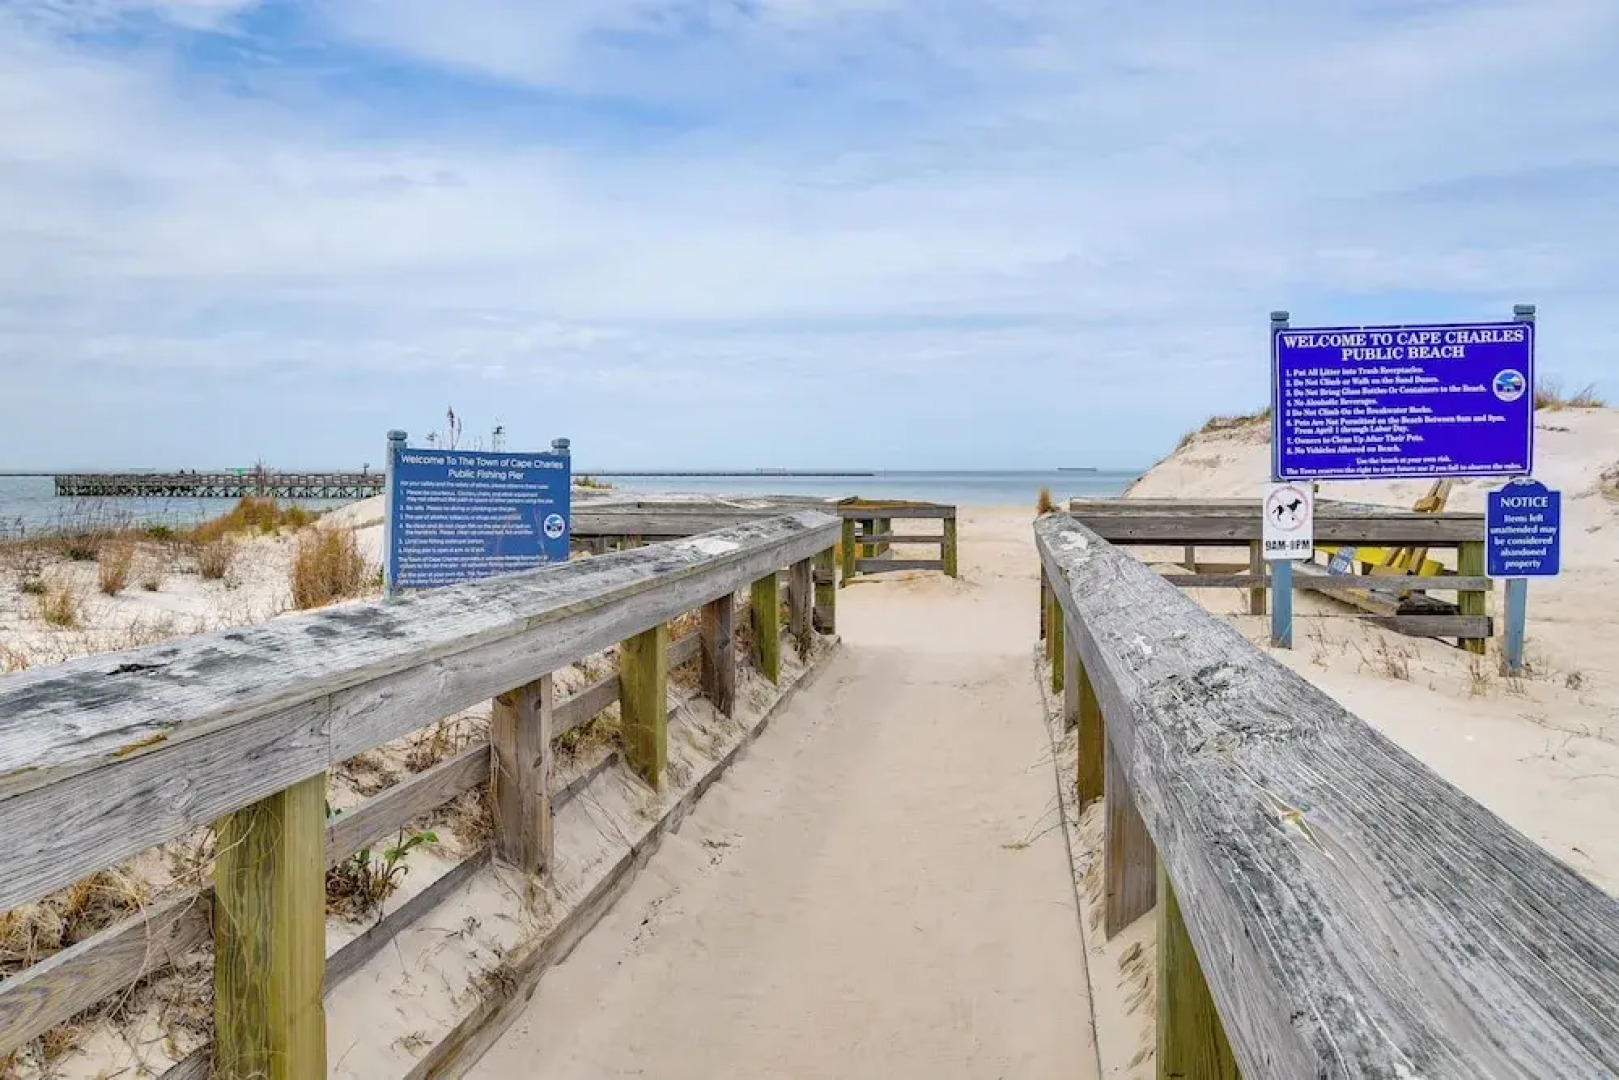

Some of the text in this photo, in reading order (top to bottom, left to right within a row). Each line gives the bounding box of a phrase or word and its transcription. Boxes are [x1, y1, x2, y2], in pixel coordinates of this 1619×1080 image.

[1284, 329, 1524, 348] WELCOME TO CAPE CHARLES
[1342, 345, 1465, 361] PUBLIC BEACH
[1294, 368, 1306, 376] Put
[1308, 368, 1318, 376] All
[1320, 368, 1340, 376] Litter
[1320, 378, 1340, 386] Climb
[1320, 388, 1340, 397] Bring
[1389, 386, 1398, 394] Or
[1400, 386, 1439, 394] Containers
[1449, 384, 1460, 392] the
[1314, 427, 1333, 435] April
[1341, 426, 1368, 435] through
[1353, 436, 1364, 444] Up
[1337, 445, 1365, 453] Allowed
[402, 455, 563, 468] Welcome To The Town of Cape Charles
[448, 469, 524, 481] Public Fishing Pier
[1501, 496, 1548, 508] NOTICE
[1504, 513, 1543, 523] Items left
[1490, 525, 1557, 535] unattended may
[1494, 536, 1553, 545] be considered
[1501, 547, 1546, 556] abandoned
[1504, 560, 1541, 570] property
